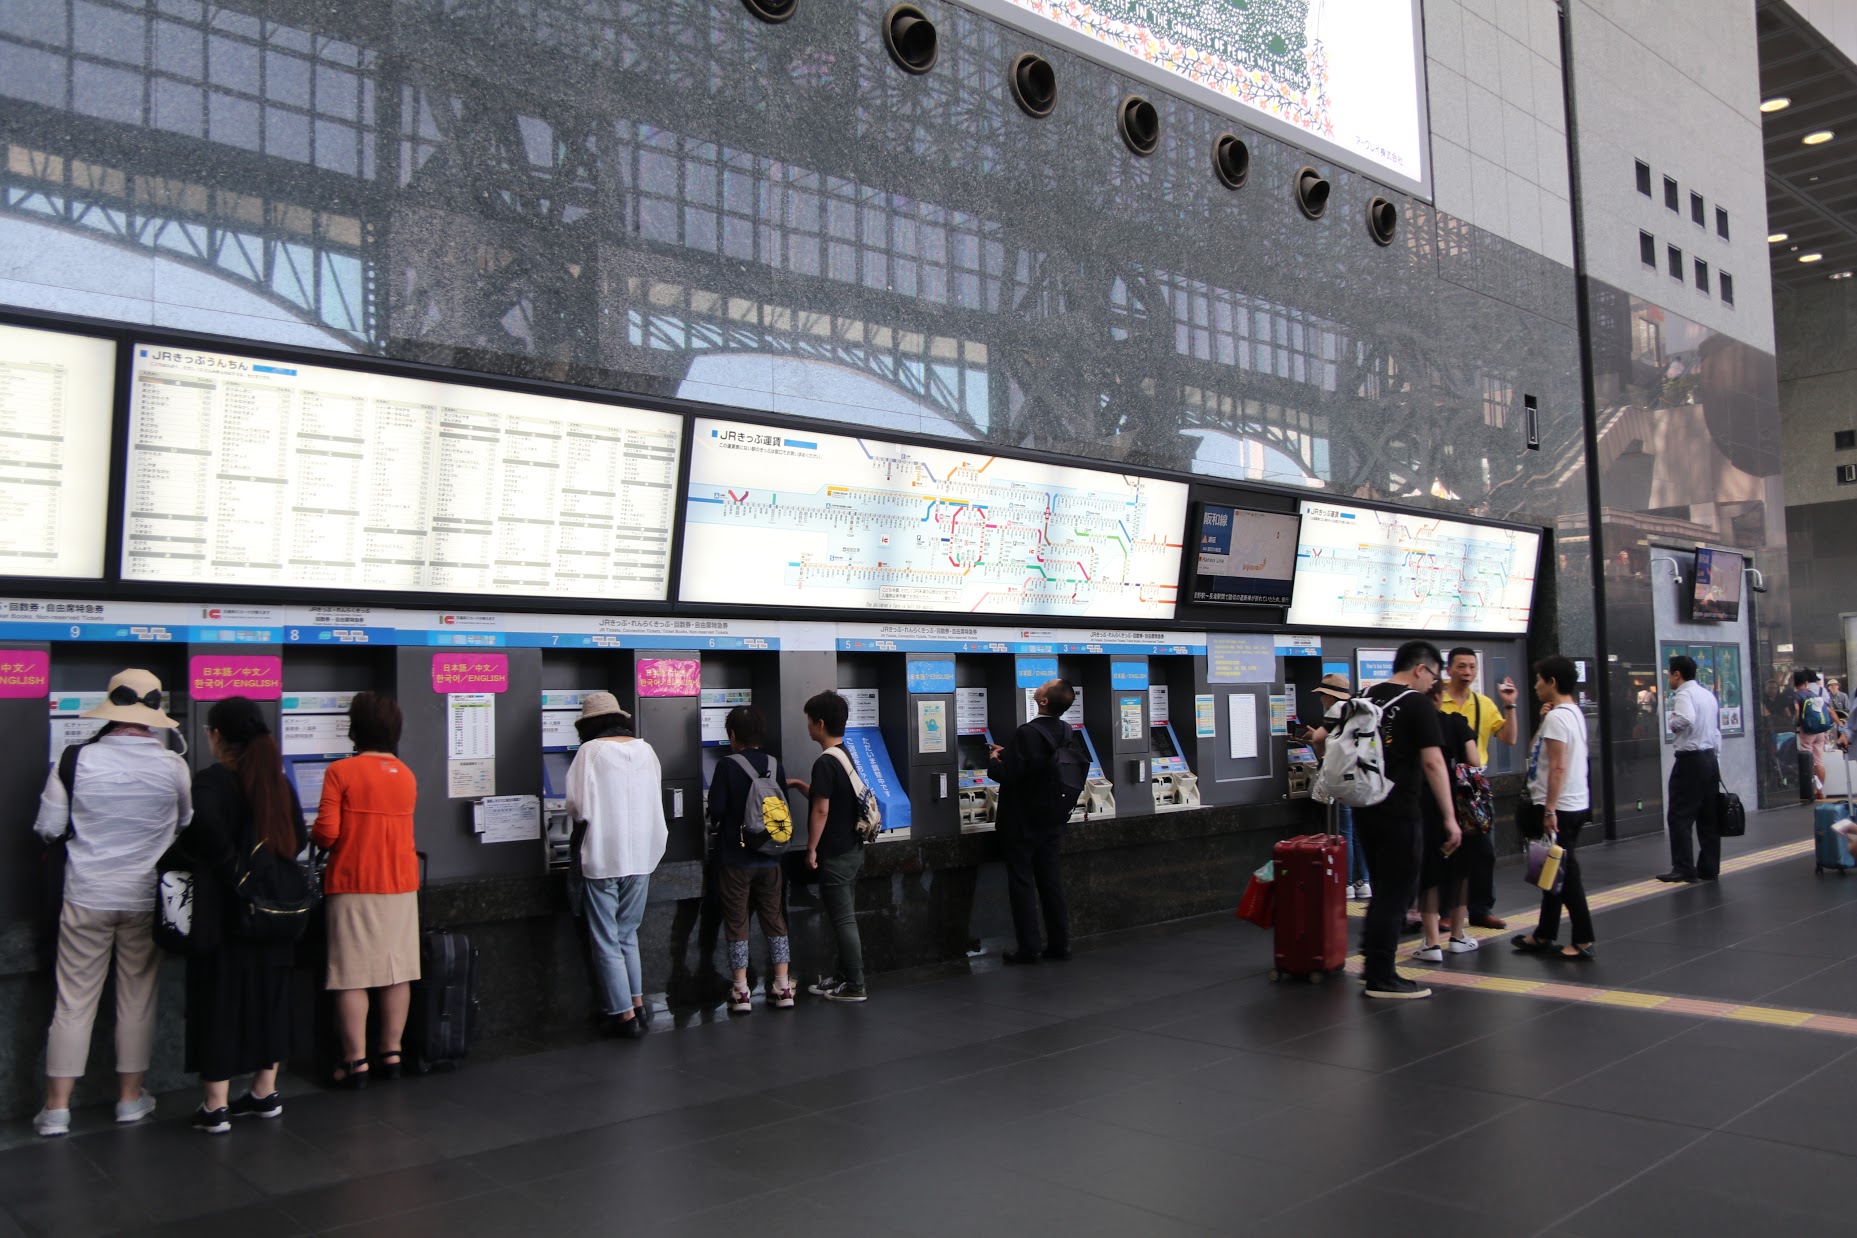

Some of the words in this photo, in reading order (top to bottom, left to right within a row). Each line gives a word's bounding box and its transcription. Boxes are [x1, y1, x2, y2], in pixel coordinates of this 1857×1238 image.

[1152, 12, 1168, 28] THE
[1214, 38, 1225, 53] OF
[1227, 44, 1255, 66] PEOPLE
[152, 351, 248, 371] JRきっぷうんちん
[720, 430, 782, 448] JRきっぷ運賃
[1204, 512, 1228, 526] 阪和線
[70, 626, 80, 638] 9
[290, 630, 299, 640] 8
[552, 636, 559, 645] 7
[709, 638, 715, 647] 6
[846, 640, 851, 649] 5
